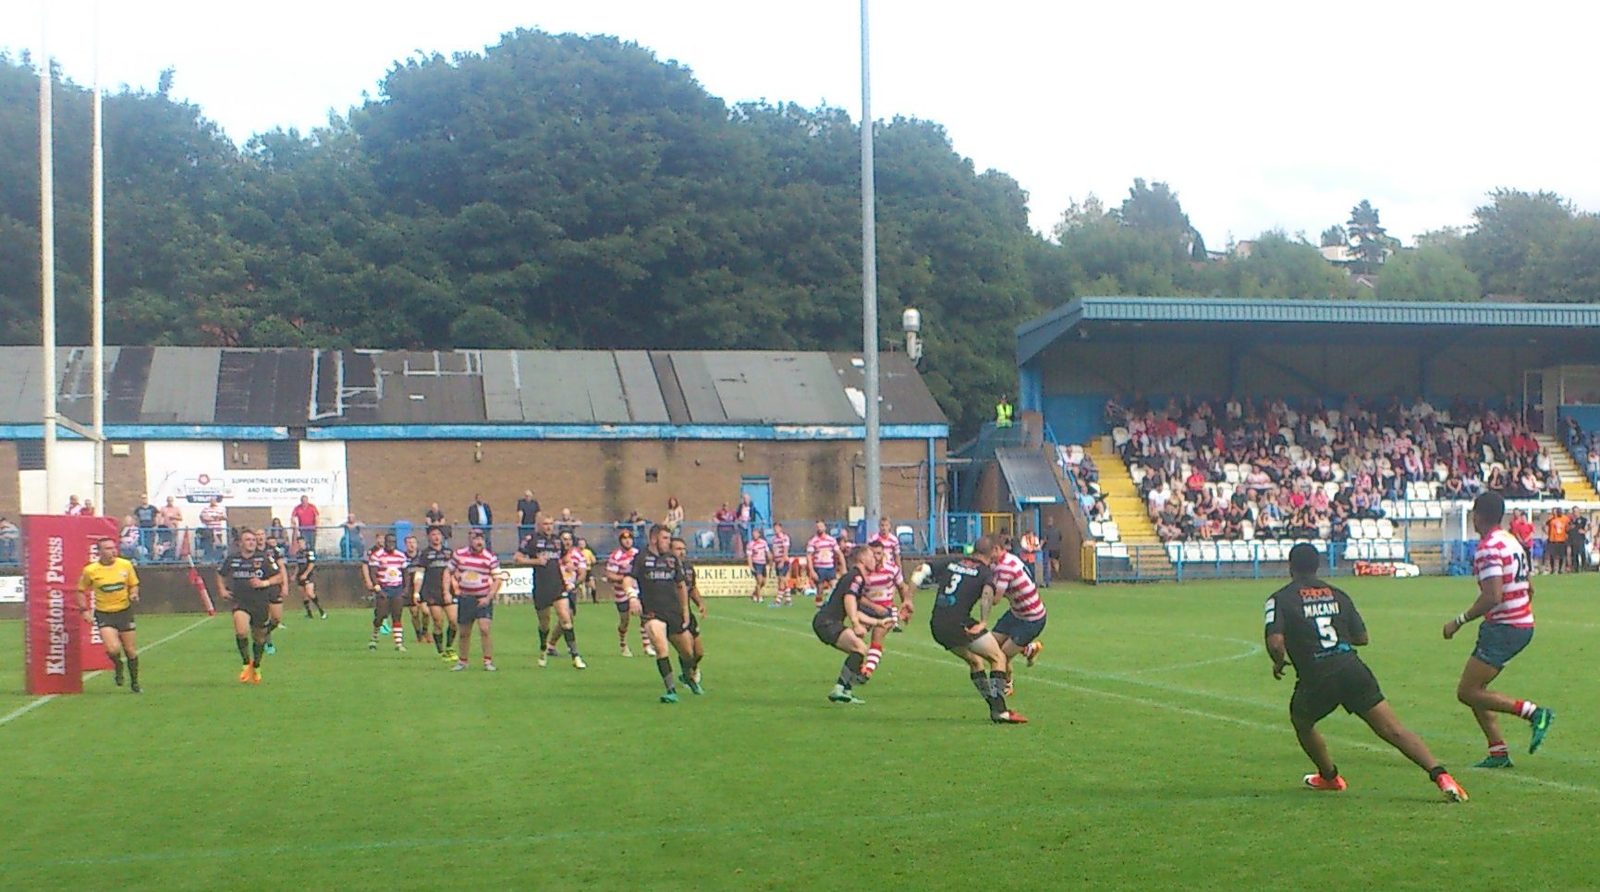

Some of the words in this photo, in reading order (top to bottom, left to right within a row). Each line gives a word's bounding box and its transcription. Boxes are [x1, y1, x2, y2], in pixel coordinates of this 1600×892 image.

[46, 536, 65, 584] Press
[944, 573, 962, 595] 3
[1303, 601, 1340, 619] MACANI
[45, 589, 69, 675] Kingstone
[1315, 616, 1338, 649] 5
